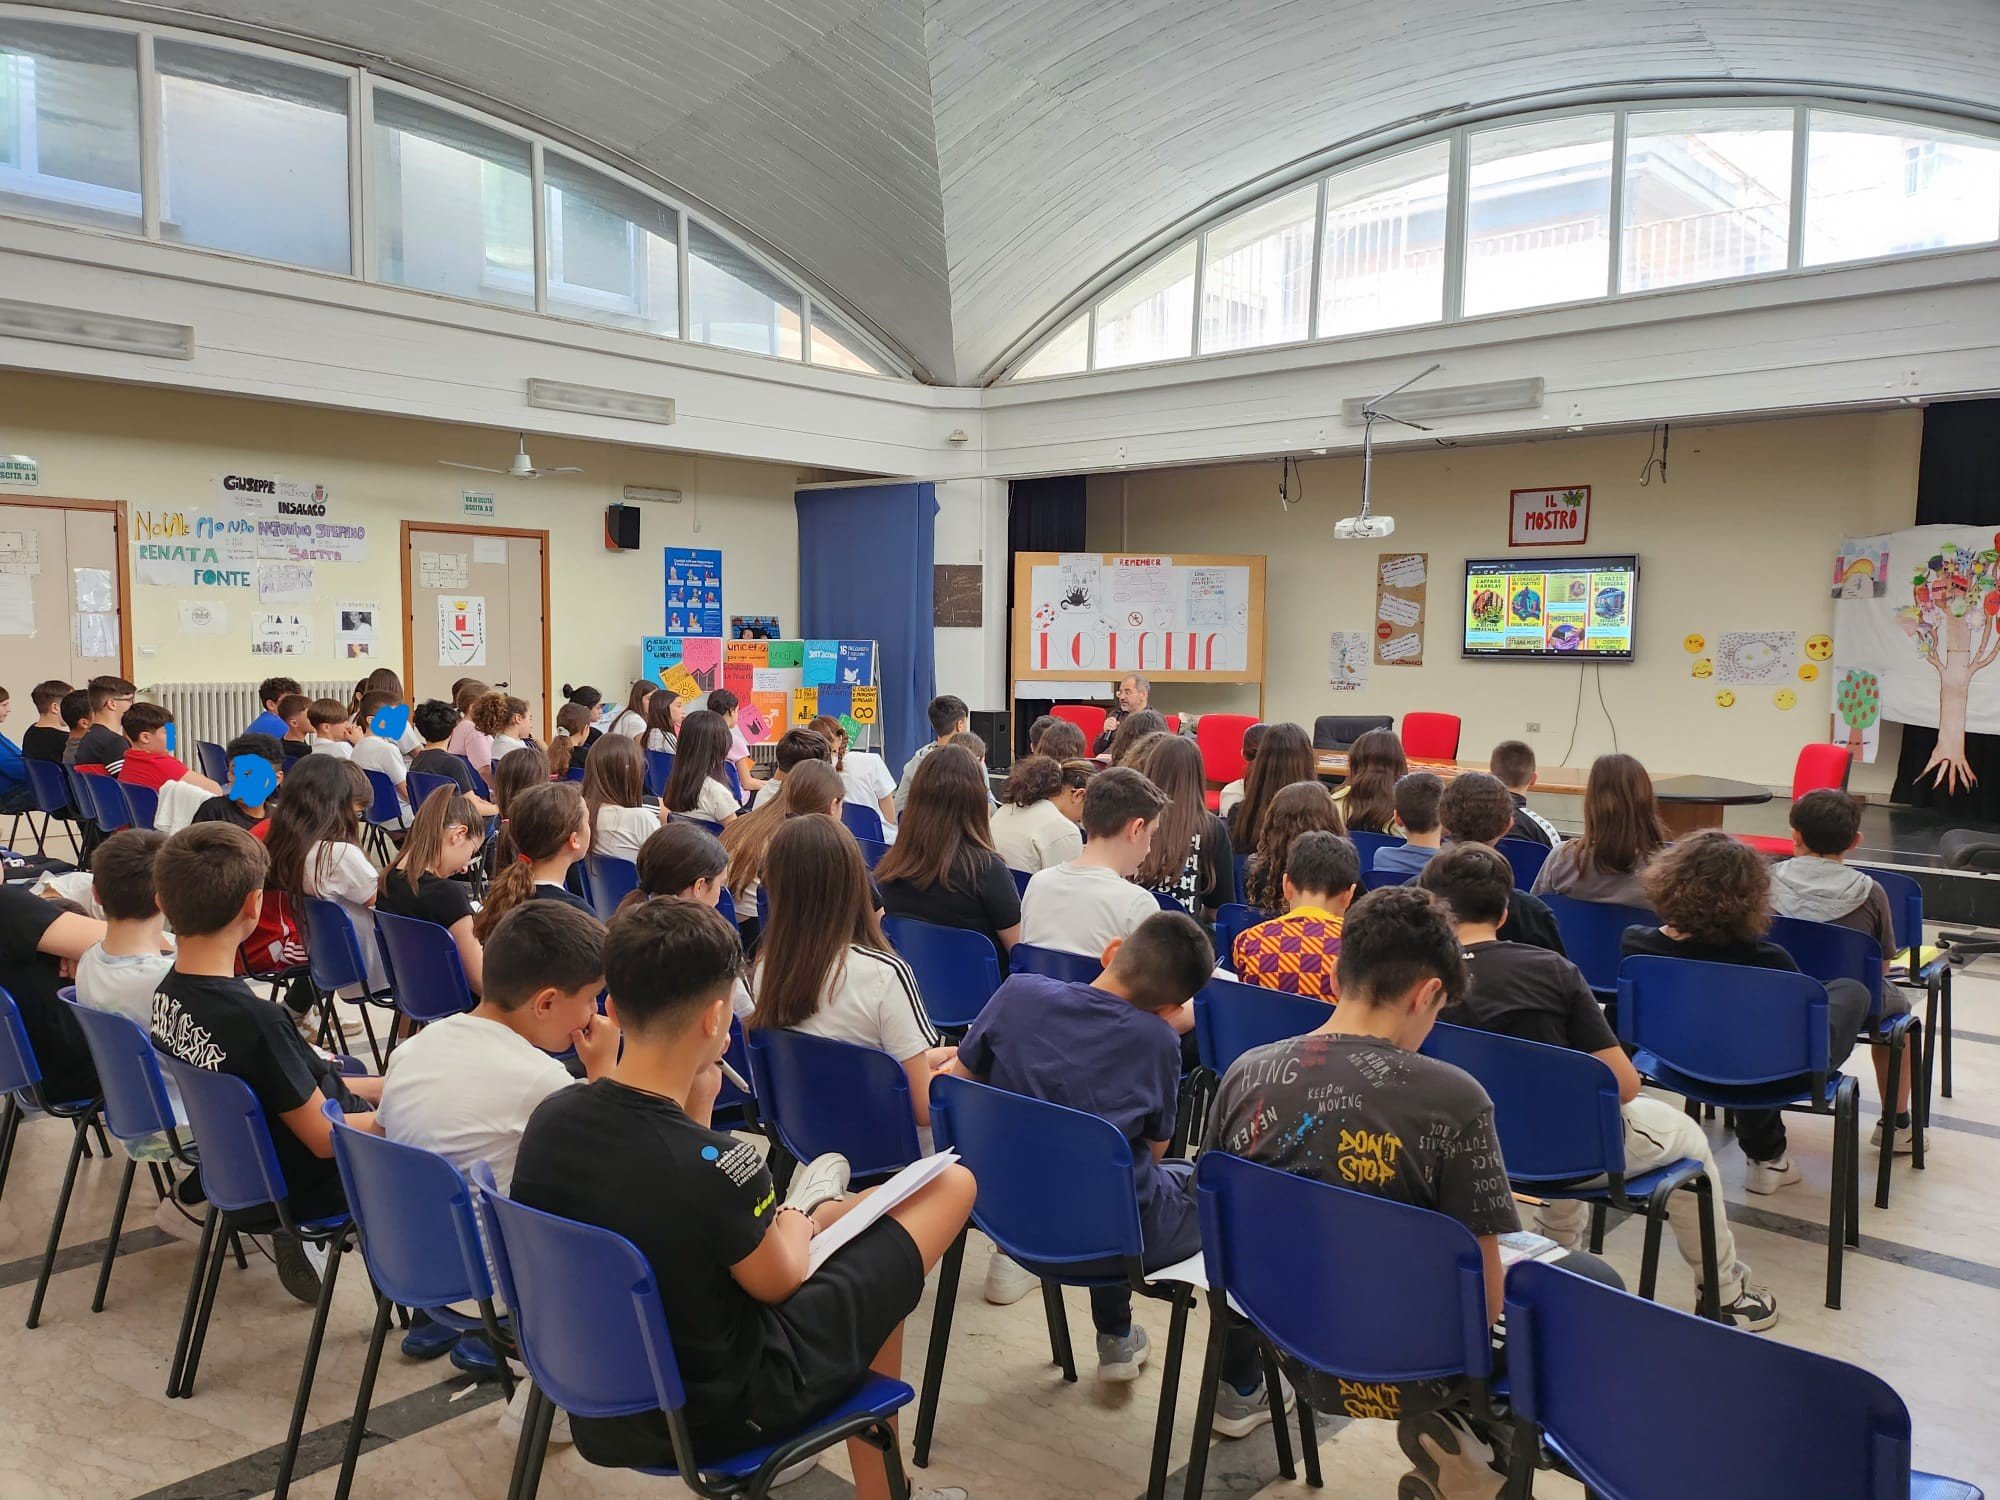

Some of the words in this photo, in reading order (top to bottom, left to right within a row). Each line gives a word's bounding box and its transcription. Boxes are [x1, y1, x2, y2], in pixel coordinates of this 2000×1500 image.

[14, 462, 35, 471] USCITA
[278, 501, 326, 517] INSALACO
[1545, 494, 1557, 508] IL
[1525, 509, 1578, 531] MOSTRO
[139, 544, 218, 563] RENATA
[1119, 558, 1161, 567] REMEMBER
[194, 569, 251, 587] FONTE
[647, 640, 652, 652] 6
[728, 643, 757, 652] unicef
[840, 645, 847, 656] 16
[1040, 631, 1096, 670] NO
[1108, 631, 1227, 671] MAFIA
[1307, 1083, 1333, 1100] KEEP
[1334, 1085, 1344, 1094] ON
[1318, 1094, 1363, 1113] MOVING
[1233, 1105, 1279, 1151] NEVER
[1443, 1134, 1489, 1160] FUTURE
[1338, 1155, 1396, 1187] STOP
[1473, 1176, 1504, 1194] LOOK
